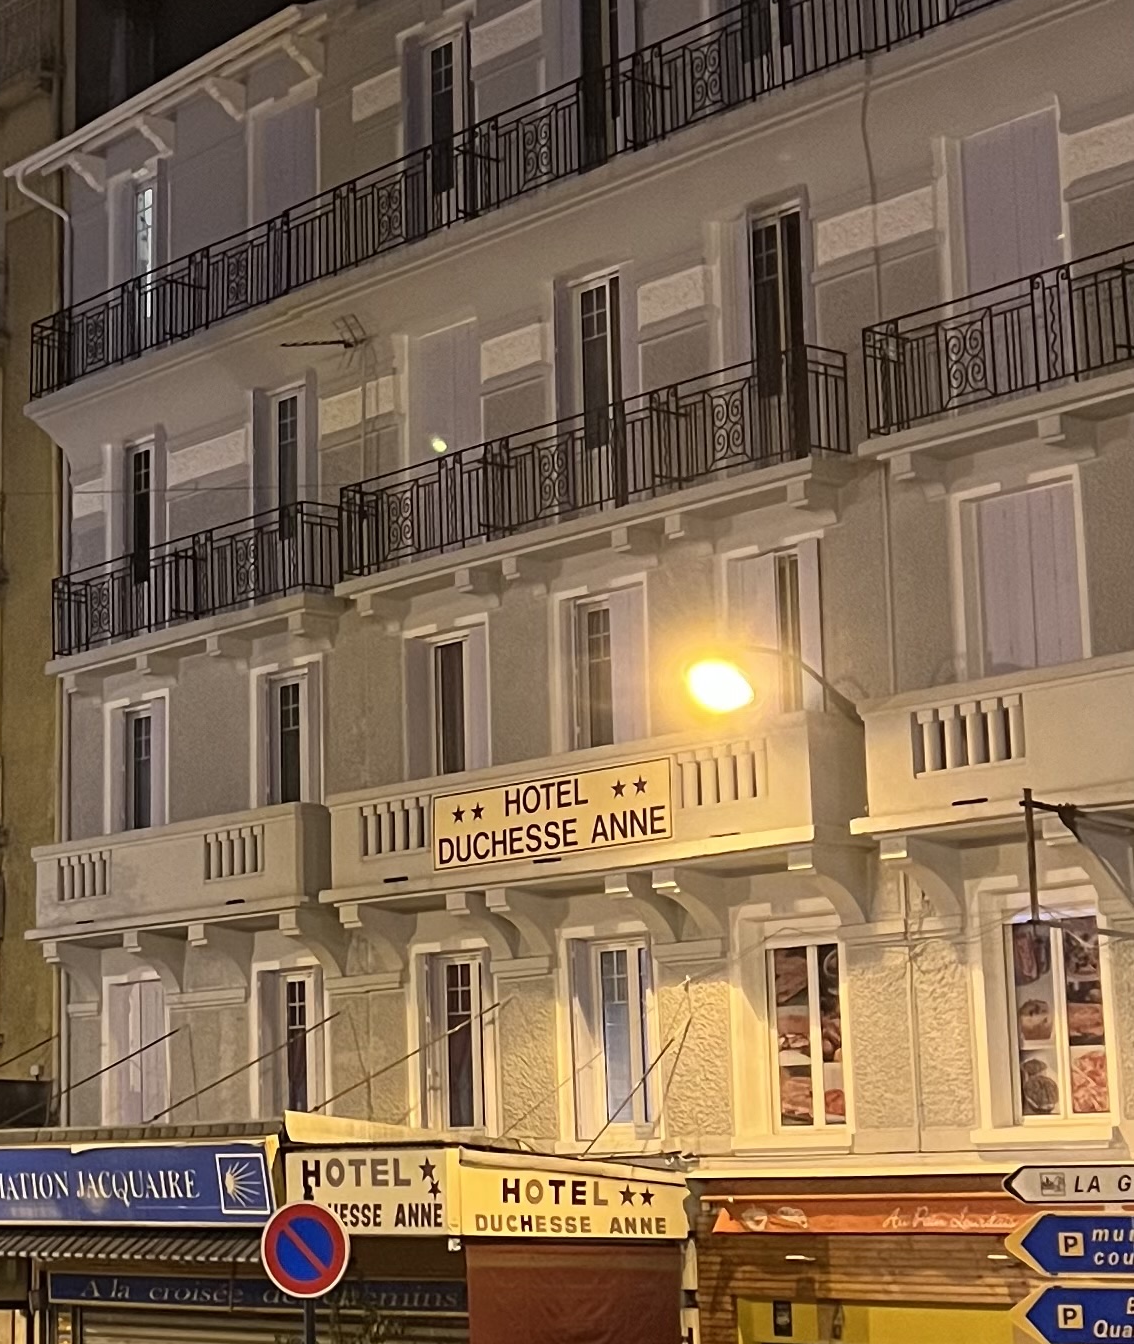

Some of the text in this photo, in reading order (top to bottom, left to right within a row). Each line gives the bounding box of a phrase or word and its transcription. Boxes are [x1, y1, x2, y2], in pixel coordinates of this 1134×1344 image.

[504, 778, 589, 818] HOTEL
[438, 805, 667, 865] DUCHESSE ANNE
[302, 1157, 412, 1188] HOTEL
[1074, 1175, 1101, 1193] LA
[76, 1168, 201, 1208] JACQUAIRE
[502, 1177, 609, 1206] HOTEL
[394, 1202, 443, 1228] ANNE
[474, 1213, 667, 1235] DUCHESSE ANNE
[882, 1206, 907, 1229] Au
[1063, 1234, 1078, 1253] P
[80, 1280, 101, 1299] A
[110, 1278, 131, 1299] la
[148, 1282, 245, 1304] croisée
[1063, 1308, 1078, 1325] P
